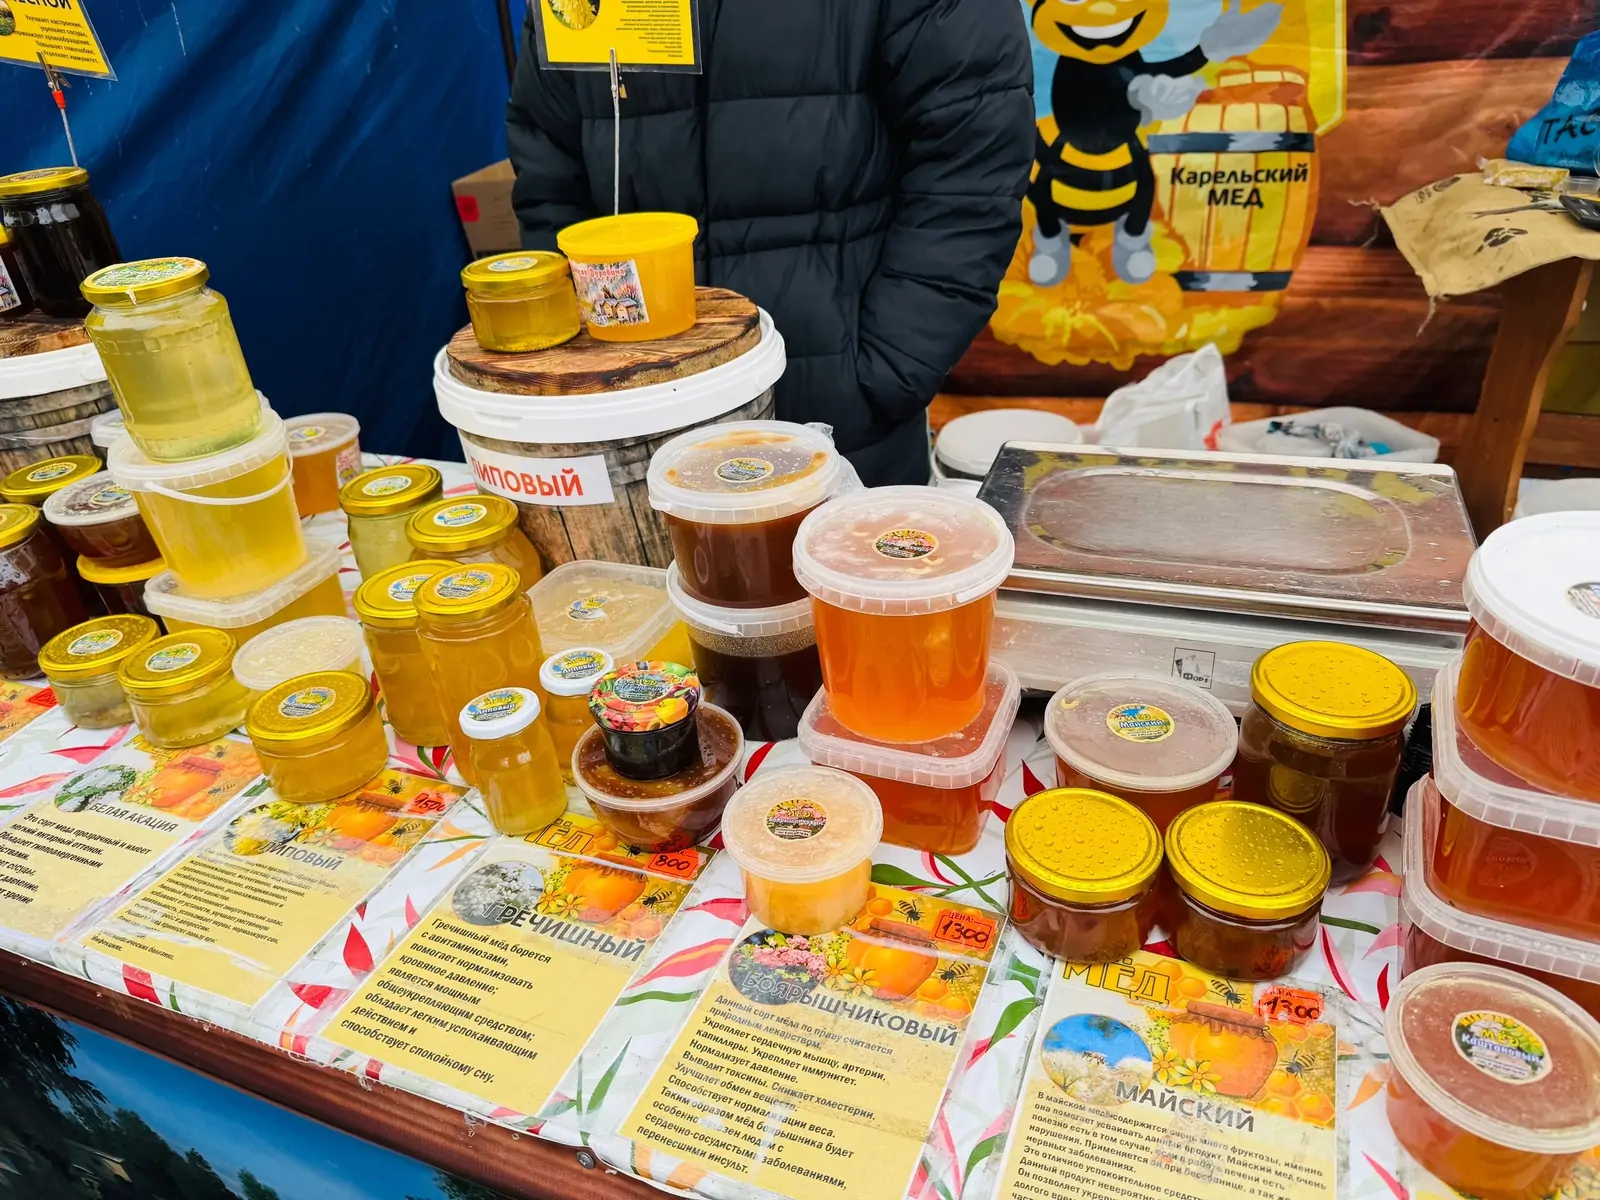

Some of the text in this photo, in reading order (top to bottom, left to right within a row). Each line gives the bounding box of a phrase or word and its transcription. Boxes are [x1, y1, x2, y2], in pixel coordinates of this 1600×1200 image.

[1170, 161, 1308, 189] Карельский
[1207, 188, 1264, 208] МЕД
[470, 455, 585, 498] ЛИПОВЫЙ
[562, 661, 600, 674] Липовый
[475, 702, 516, 716] Липовый
[1119, 719, 1164, 729] Майский
[89, 800, 179, 833] БЕЛАЯ АКАЦИЯ
[264, 837, 344, 872] ЛИПОВЫЙ
[655, 854, 691, 871] 800
[482, 901, 647, 963] ГРЕЧИШНЫЙ
[942, 919, 989, 943] 1300
[948, 911, 974, 924] ЦЕНА:
[428, 934, 508, 967] авитаминозами,
[431, 918, 551, 963] Гречишный мёд борется
[387, 967, 481, 1005] является мощным
[399, 954, 498, 995] кровяное давление;
[410, 943, 533, 989] помогает нормализовать
[350, 1006, 417, 1035] действием и
[365, 992, 537, 1059] обладает легким успокаивающим
[376, 980, 535, 1042] общеукрепляющим средством;
[709, 1007, 822, 1049] природным лекарством.
[714, 995, 893, 1055] Данный сорт мёда по праву считается
[741, 970, 960, 1047] БОЯРЫШНИКОВЫЙ
[1264, 995, 1320, 1021] 1300
[341, 1019, 494, 1083] способствует спокойному сну.
[689, 1039, 797, 1083] Нормализует давление.
[696, 1029, 856, 1085] капилляры. Укрепляет иммунитет.
[702, 1016, 885, 1081] Укрепляет сердечную мышцу, артерии,
[1460, 1032, 1541, 1063] Каштановый
[674, 1061, 720, 1085] Улучшает
[720, 1081, 751, 1096] обмен
[682, 1050, 875, 1120] Выводит токсины. Снижает холестерин.
[661, 1086, 690, 1105] Таким
[734, 1115, 754, 1129] мёд
[825, 1142, 854, 1158] будет
[668, 1074, 734, 1104] Способствует
[808, 1124, 835, 1137] веса.
[1115, 1081, 1256, 1133] МАЙСКИЙ
[636, 1126, 747, 1173] перенесшими инсульт.
[761, 1156, 846, 1190] заболеваниями,
